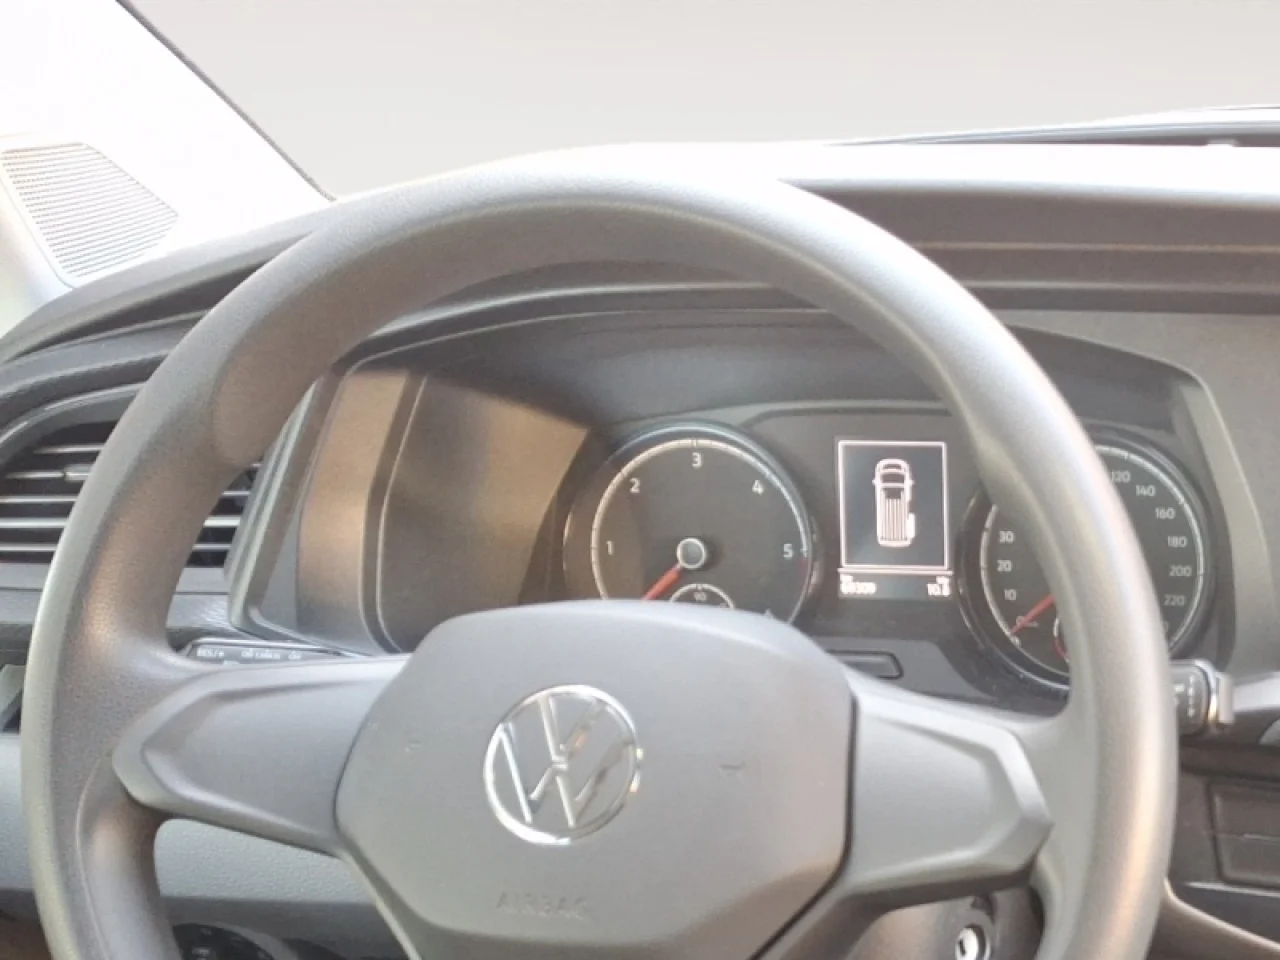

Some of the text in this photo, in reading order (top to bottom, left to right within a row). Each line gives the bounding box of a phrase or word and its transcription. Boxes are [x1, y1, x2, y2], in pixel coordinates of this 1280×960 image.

[691, 452, 702, 468] 3
[629, 478, 640, 493] 2
[752, 480, 764, 494] 4
[1136, 485, 1155, 496] 140
[1155, 507, 1175, 519] 160
[1000, 530, 1015, 543] 30
[1168, 536, 1187, 547] 180
[606, 540, 613, 555] 1
[783, 543, 793, 558] 5
[997, 560, 1012, 572] 20
[1169, 565, 1192, 576] 200
[1004, 589, 1016, 601] 10
[1165, 595, 1184, 606] 220
